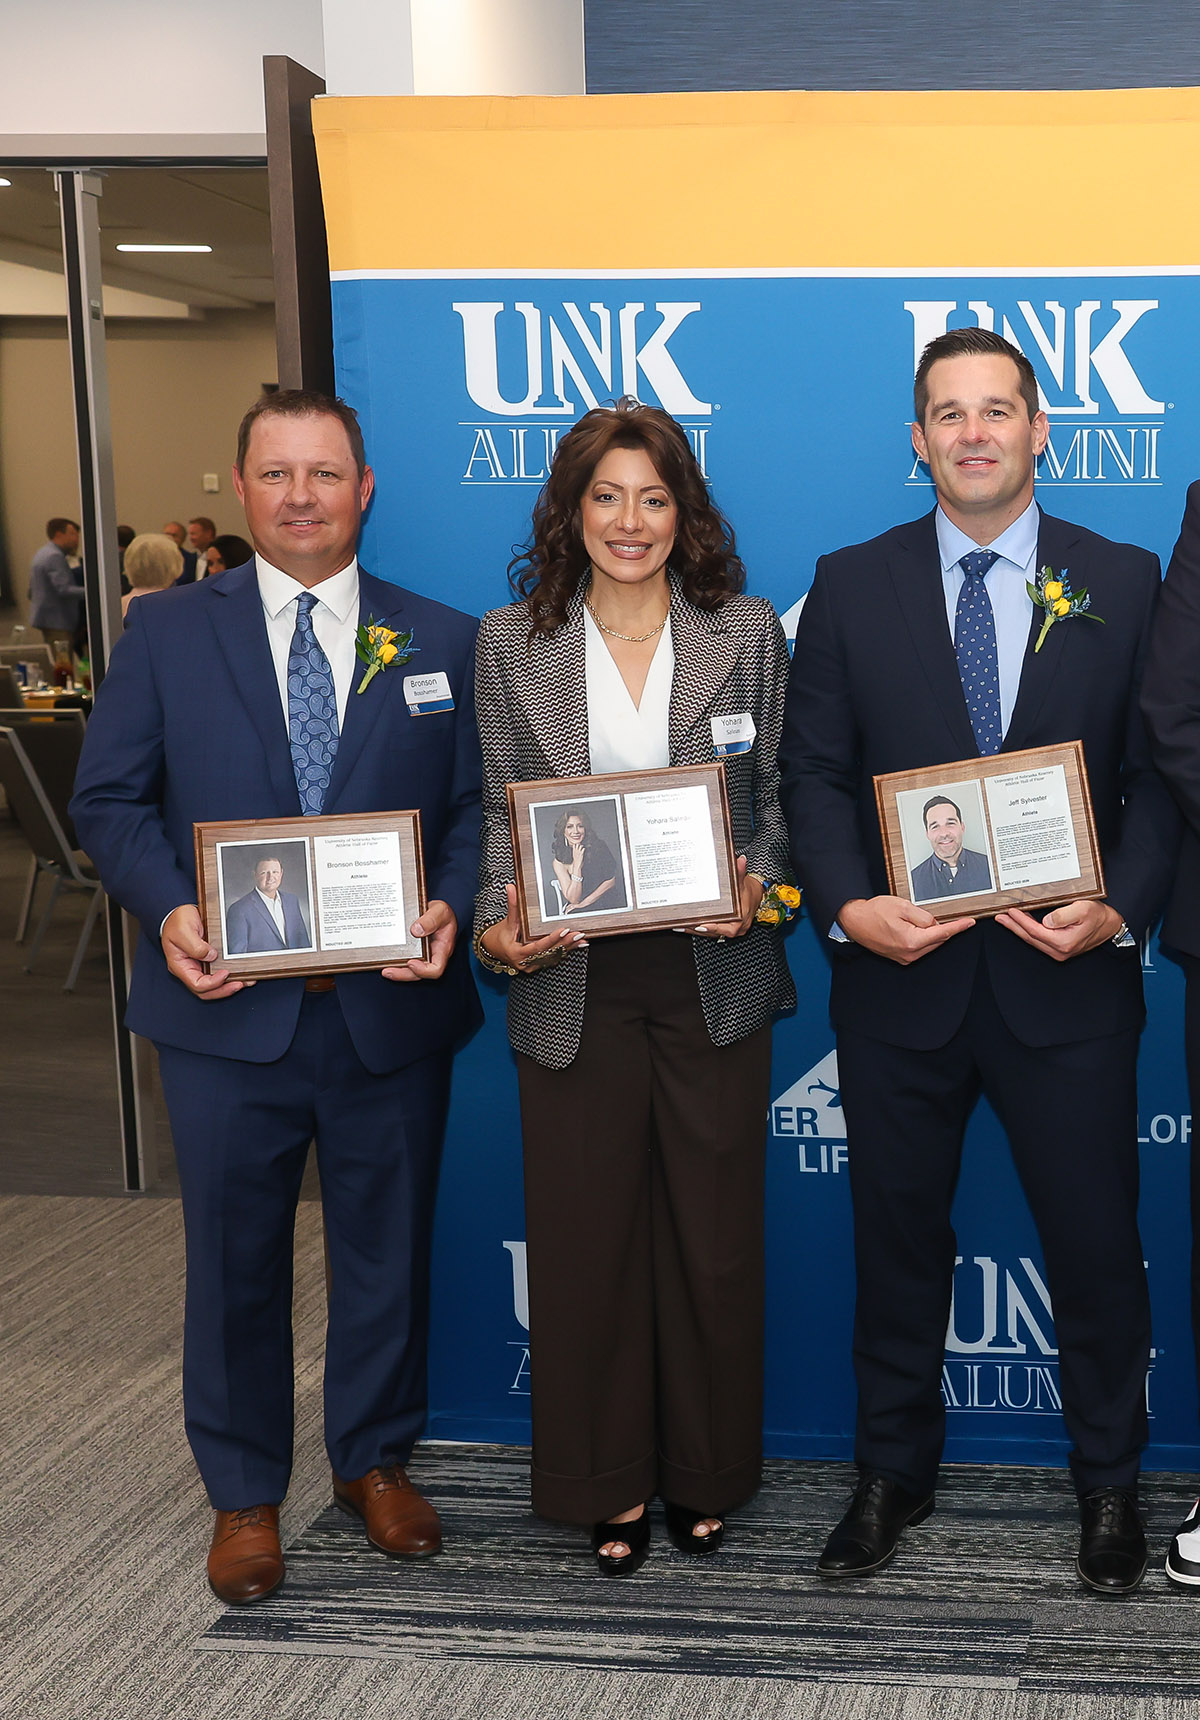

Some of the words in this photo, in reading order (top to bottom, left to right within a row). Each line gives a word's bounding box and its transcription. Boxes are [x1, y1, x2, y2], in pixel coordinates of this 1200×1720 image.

[452, 302, 712, 416] UNK
[410, 678, 438, 688] Bronson
[1008, 799, 1020, 807] Jeff
[1020, 795, 1047, 805] Sylvester
[646, 817, 668, 825] Yohara
[354, 859, 389, 867] Bosshamer
[798, 1144, 849, 1174] LIF
